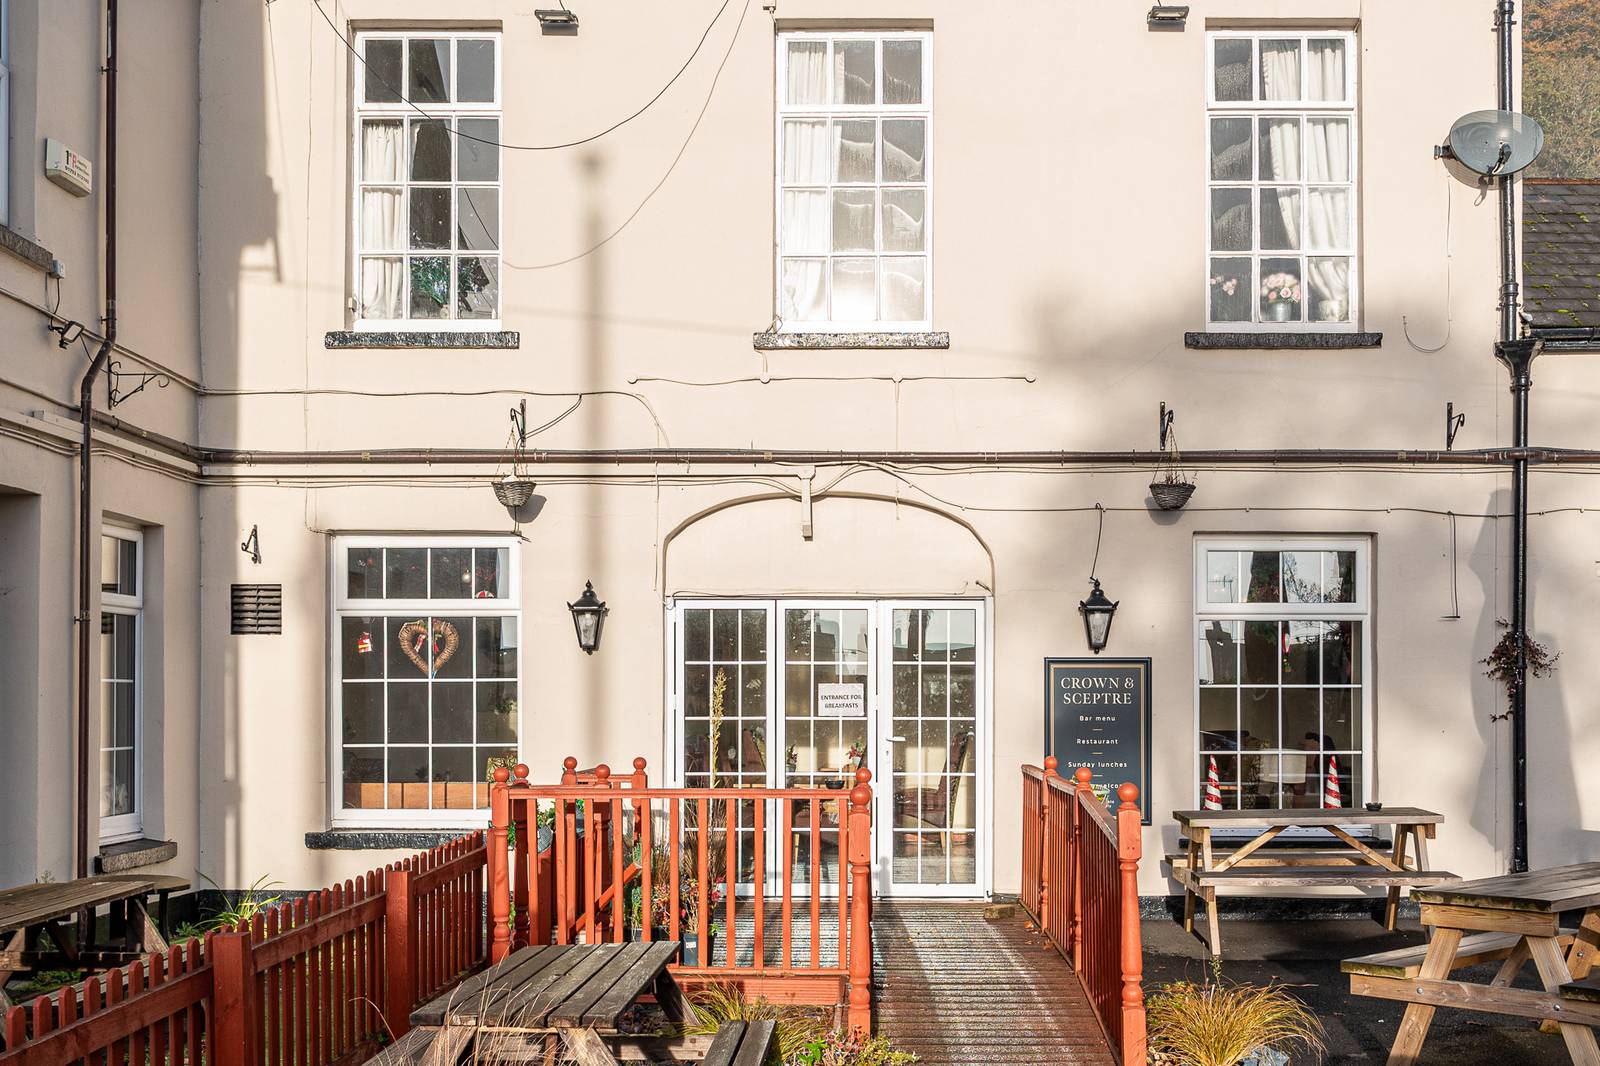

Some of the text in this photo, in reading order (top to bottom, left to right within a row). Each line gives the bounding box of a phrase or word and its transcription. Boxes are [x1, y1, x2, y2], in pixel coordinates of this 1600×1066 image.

[1060, 677, 1134, 689] CROWN &
[1063, 692, 1132, 705] SCEPTRE
[1068, 761, 1096, 769] Sunday
